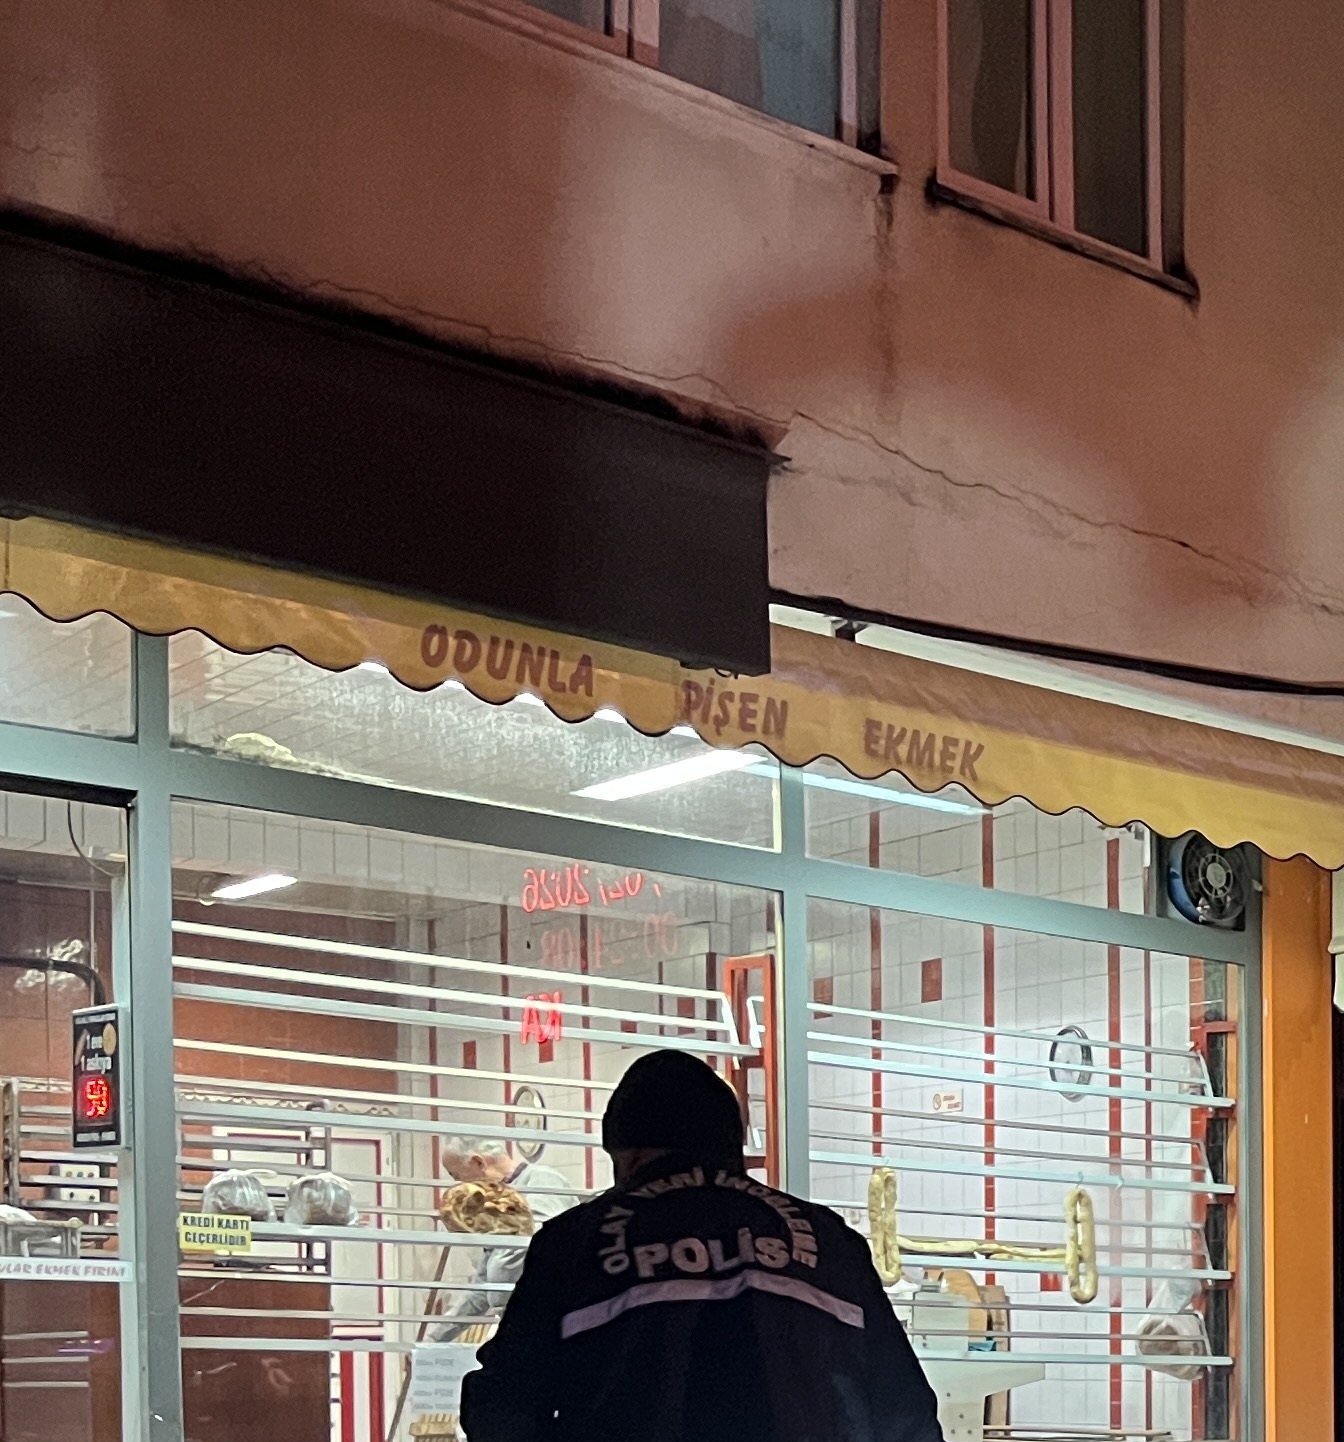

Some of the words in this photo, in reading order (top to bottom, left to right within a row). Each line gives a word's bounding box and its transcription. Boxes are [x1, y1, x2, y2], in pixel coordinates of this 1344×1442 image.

[420, 623, 594, 698] ODUNLA
[681, 678, 789, 739] PİŞEN
[863, 718, 986, 781] EKMEK
[183, 1215, 214, 1228] KREDİ
[217, 1218, 249, 1231] KARTI
[35, 1264, 79, 1276] EKMEK
